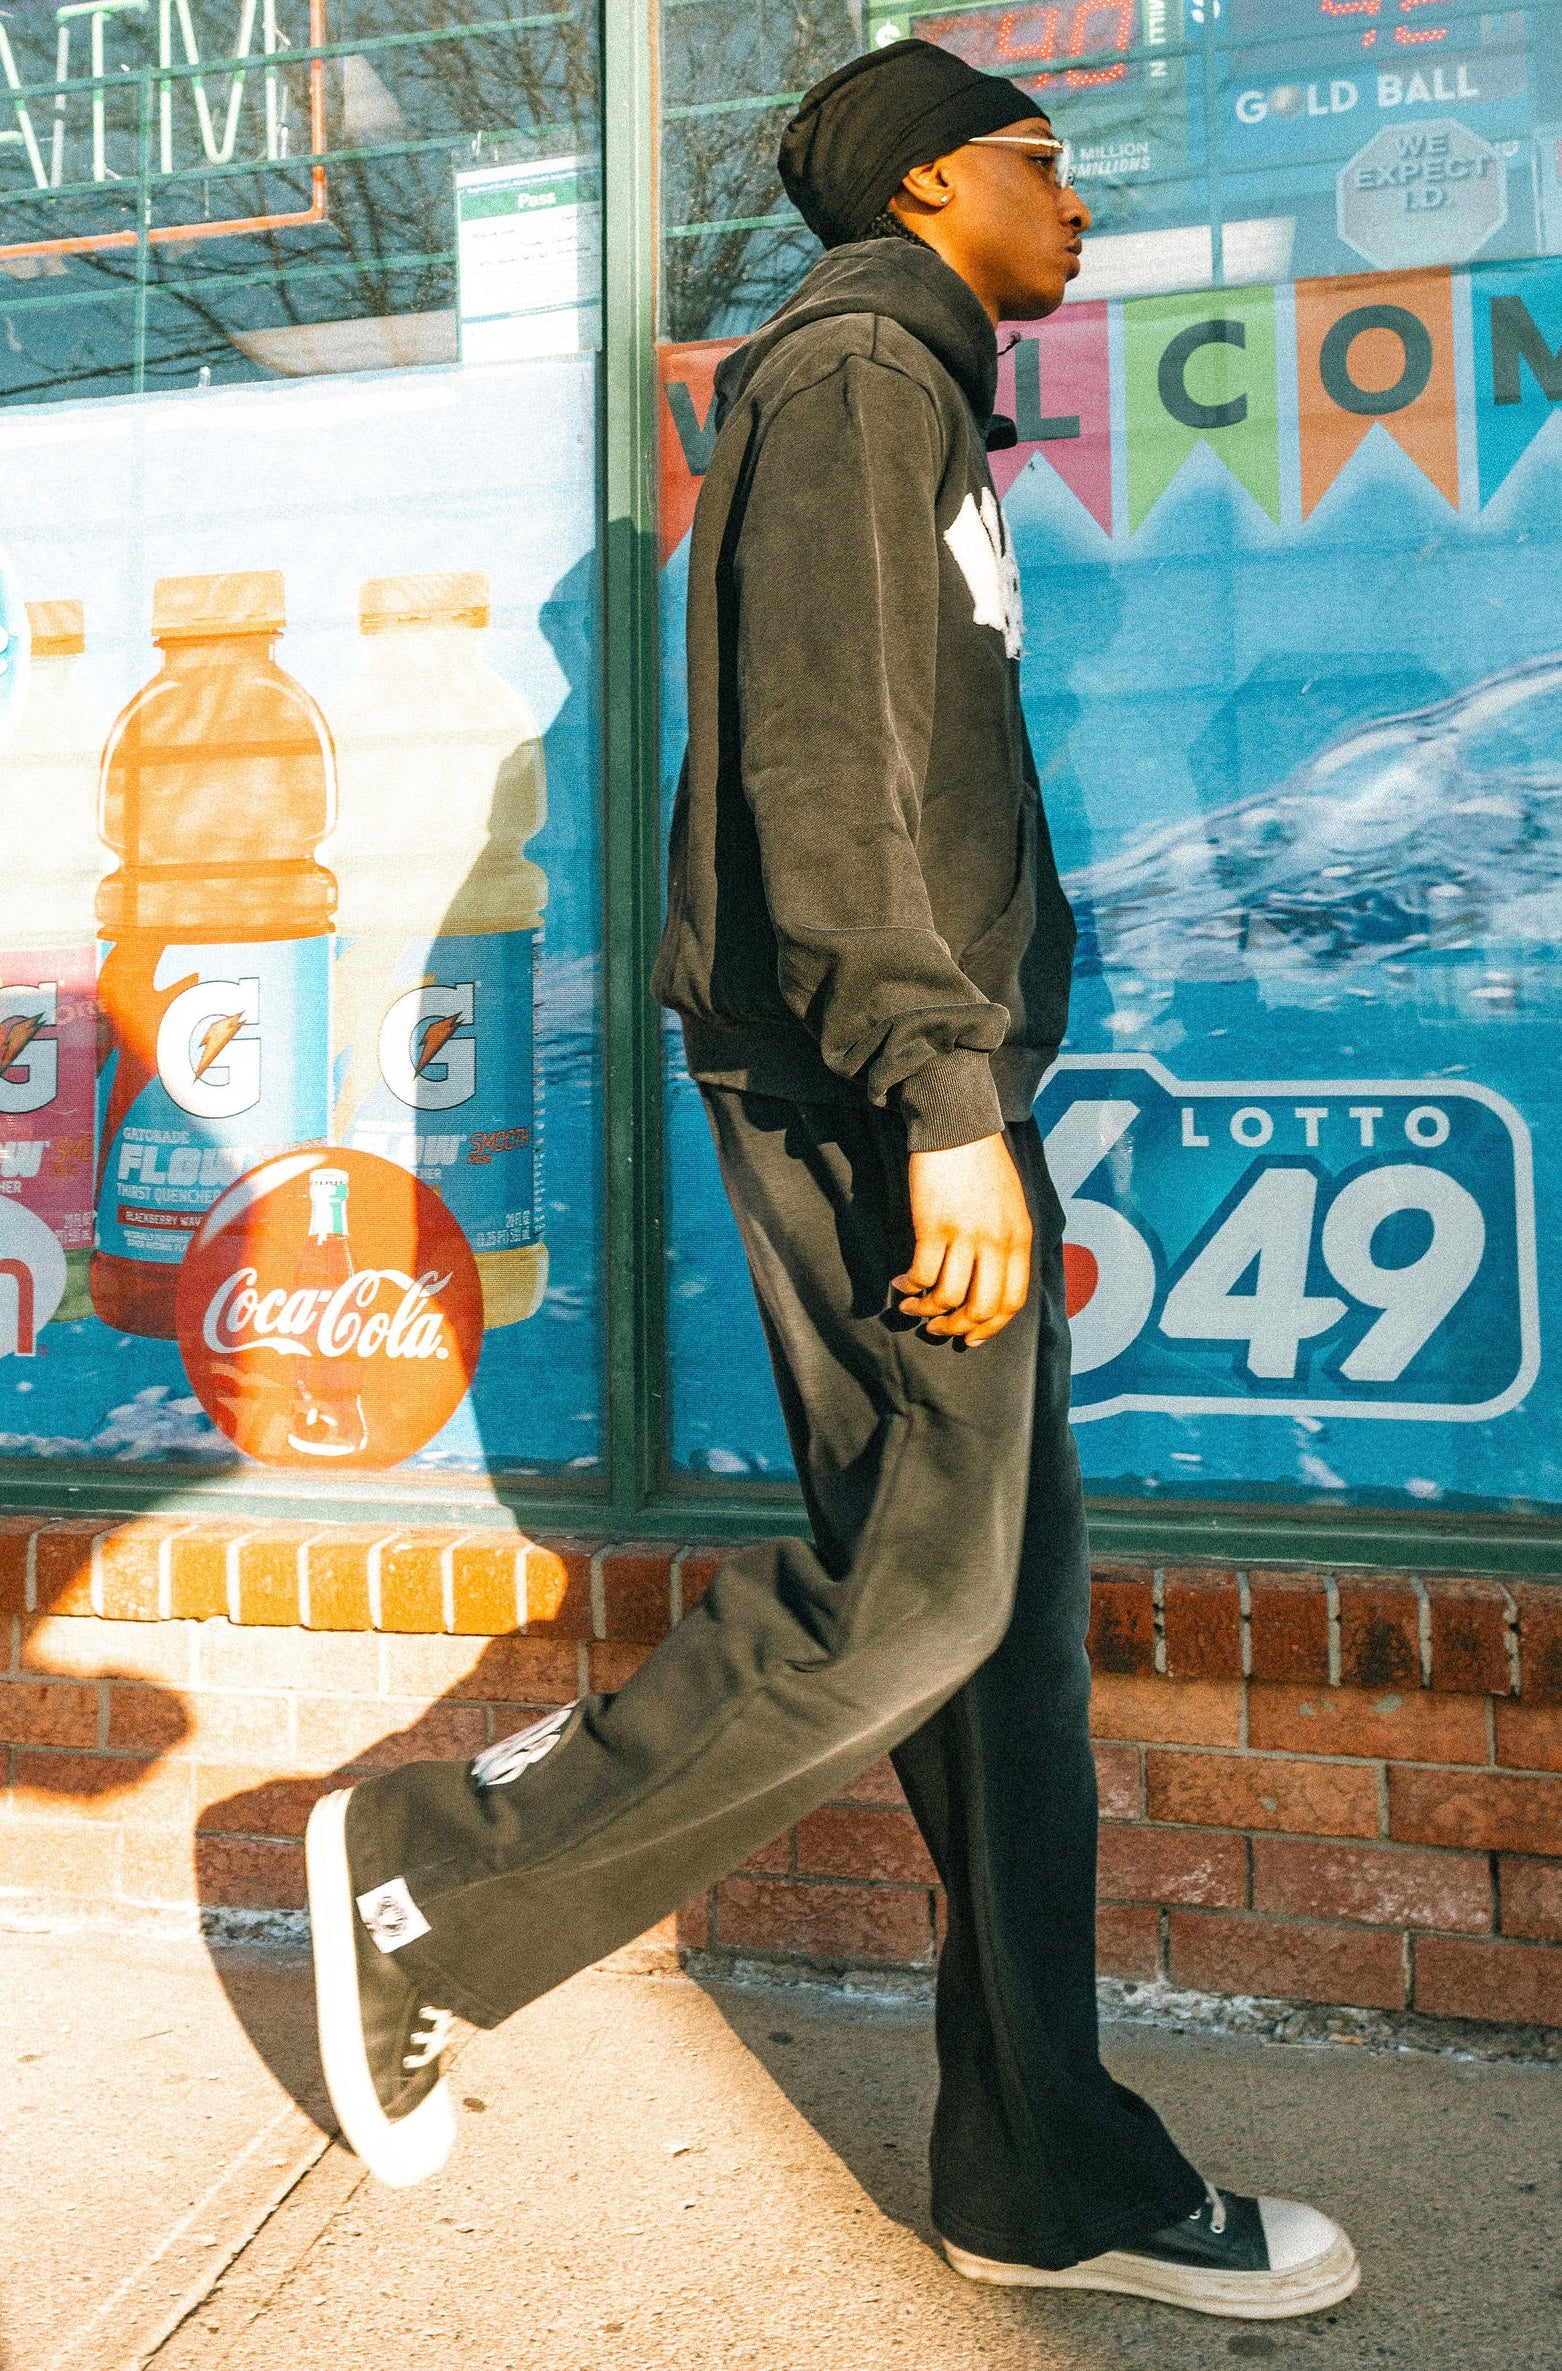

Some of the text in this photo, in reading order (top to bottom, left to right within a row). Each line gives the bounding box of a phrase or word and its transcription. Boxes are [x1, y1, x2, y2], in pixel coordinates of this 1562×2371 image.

[1377, 65, 1481, 108] BALL
[1395, 132, 1451, 159] WE
[1355, 155, 1491, 191] EXPECT
[1180, 1105, 1452, 1149] LOTTO
[117, 1143, 248, 1187] FLOW
